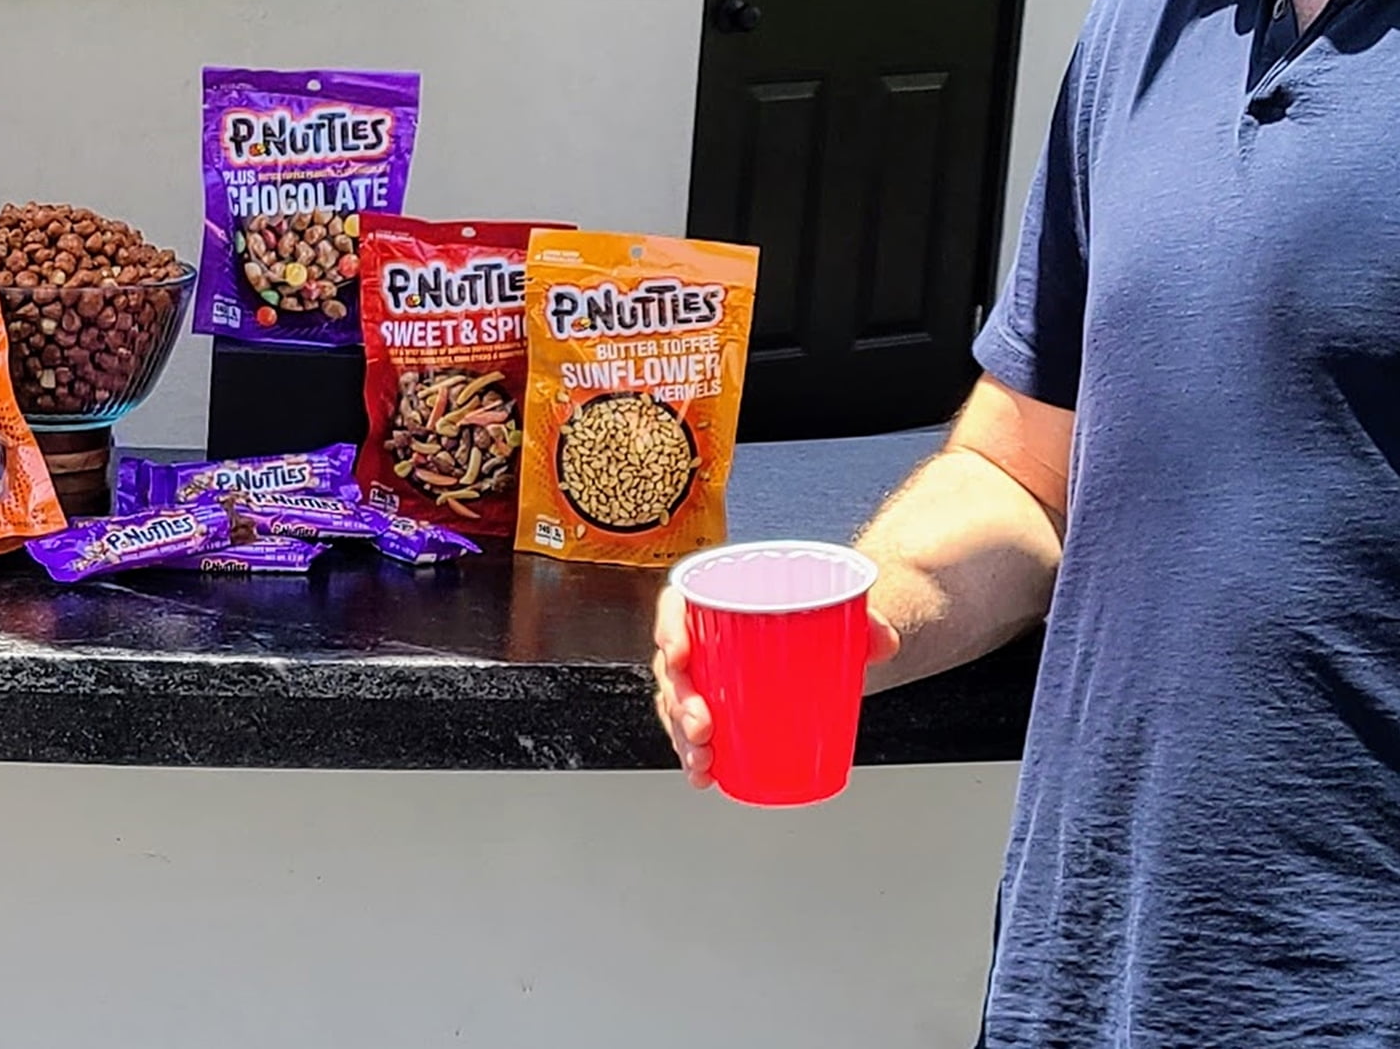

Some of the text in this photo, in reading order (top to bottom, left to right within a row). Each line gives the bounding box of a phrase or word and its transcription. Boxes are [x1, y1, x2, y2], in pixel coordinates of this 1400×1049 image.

[223, 170, 256, 185] PLUS
[227, 177, 389, 217] CHOCOLATE
[388, 263, 527, 308] P.NUTTLE
[381, 320, 457, 346] SWEET
[460, 319, 478, 344] &
[596, 334, 720, 361] BUTTER TOFFEE
[561, 352, 721, 389] SUNFLOWER
[654, 379, 721, 402] KERNELS
